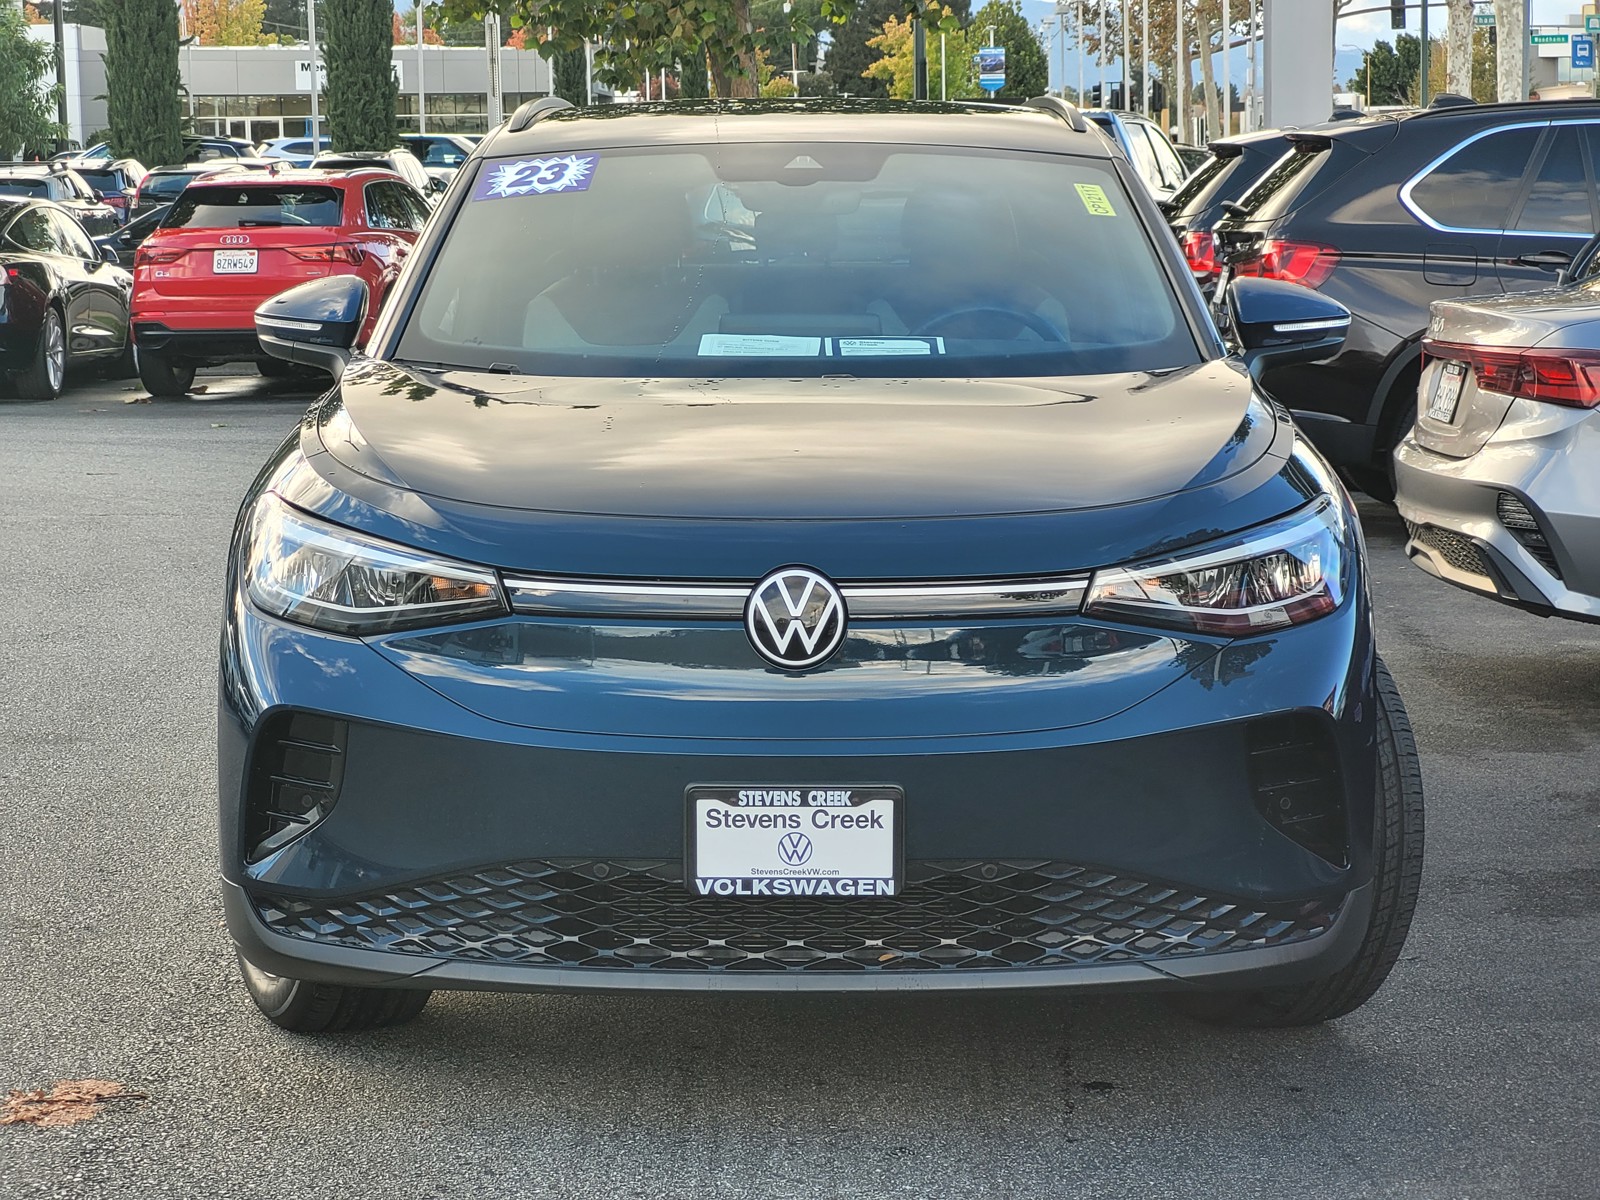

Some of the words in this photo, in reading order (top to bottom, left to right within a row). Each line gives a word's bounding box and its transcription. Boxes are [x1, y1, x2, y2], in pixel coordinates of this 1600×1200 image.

[505, 162, 570, 188] 23
[216, 258, 255, 270] 8ZRW549
[738, 790, 801, 807] STEVENS
[807, 790, 852, 807] CREEK
[705, 808, 801, 829] Stevens
[811, 808, 884, 829] Creek
[750, 867, 840, 876] StevensCreekVW.com
[695, 878, 895, 896] VOLKSWAGEN
